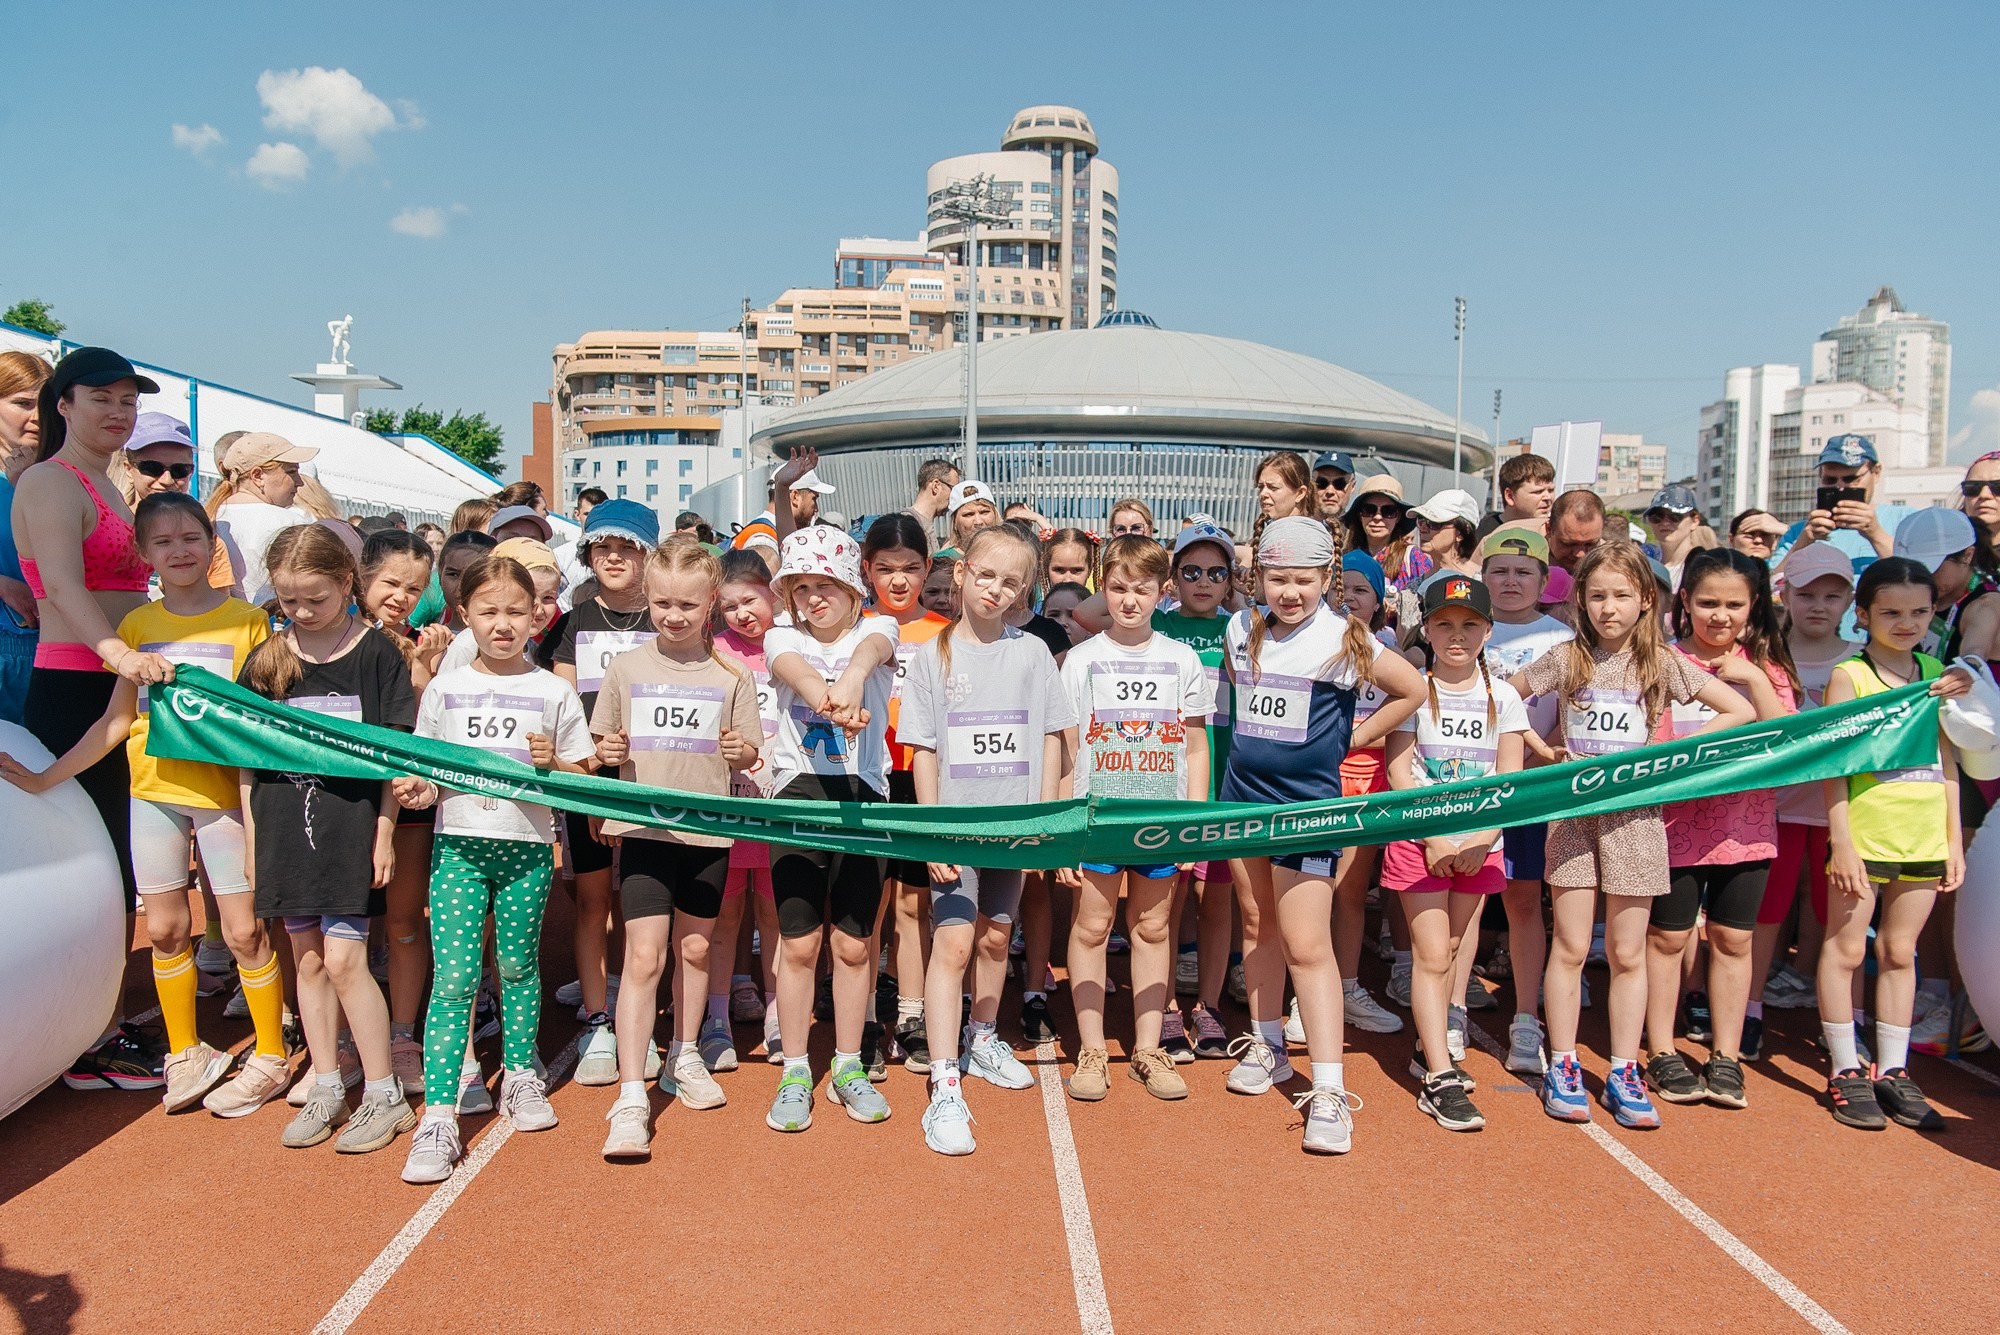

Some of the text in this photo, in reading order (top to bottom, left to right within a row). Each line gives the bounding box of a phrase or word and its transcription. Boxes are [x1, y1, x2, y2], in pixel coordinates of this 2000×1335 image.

[1116, 681, 1158, 701] 392
[1248, 694, 1287, 718] 408
[467, 716, 518, 739] 569
[653, 706, 700, 730] 054
[1441, 717, 1483, 739] 548
[1586, 710, 1630, 733] 204
[1125, 735, 1145, 743] ФКР
[1264, 729, 1280, 737] лет
[1807, 723, 1877, 743] марафо
[676, 741, 693, 749] лет
[973, 732, 1017, 755] 554
[1607, 744, 1625, 752] лет
[1095, 751, 1175, 772] УФА 2025
[1463, 750, 1478, 758] лет
[431, 767, 511, 790] марафон
[998, 766, 1014, 774] лет
[1612, 754, 1690, 784] СБЕР
[1413, 787, 1482, 805] зелёный
[1402, 801, 1474, 820] марафон
[1178, 820, 1264, 843] СБЕР
[1281, 812, 1347, 832] Прайм
